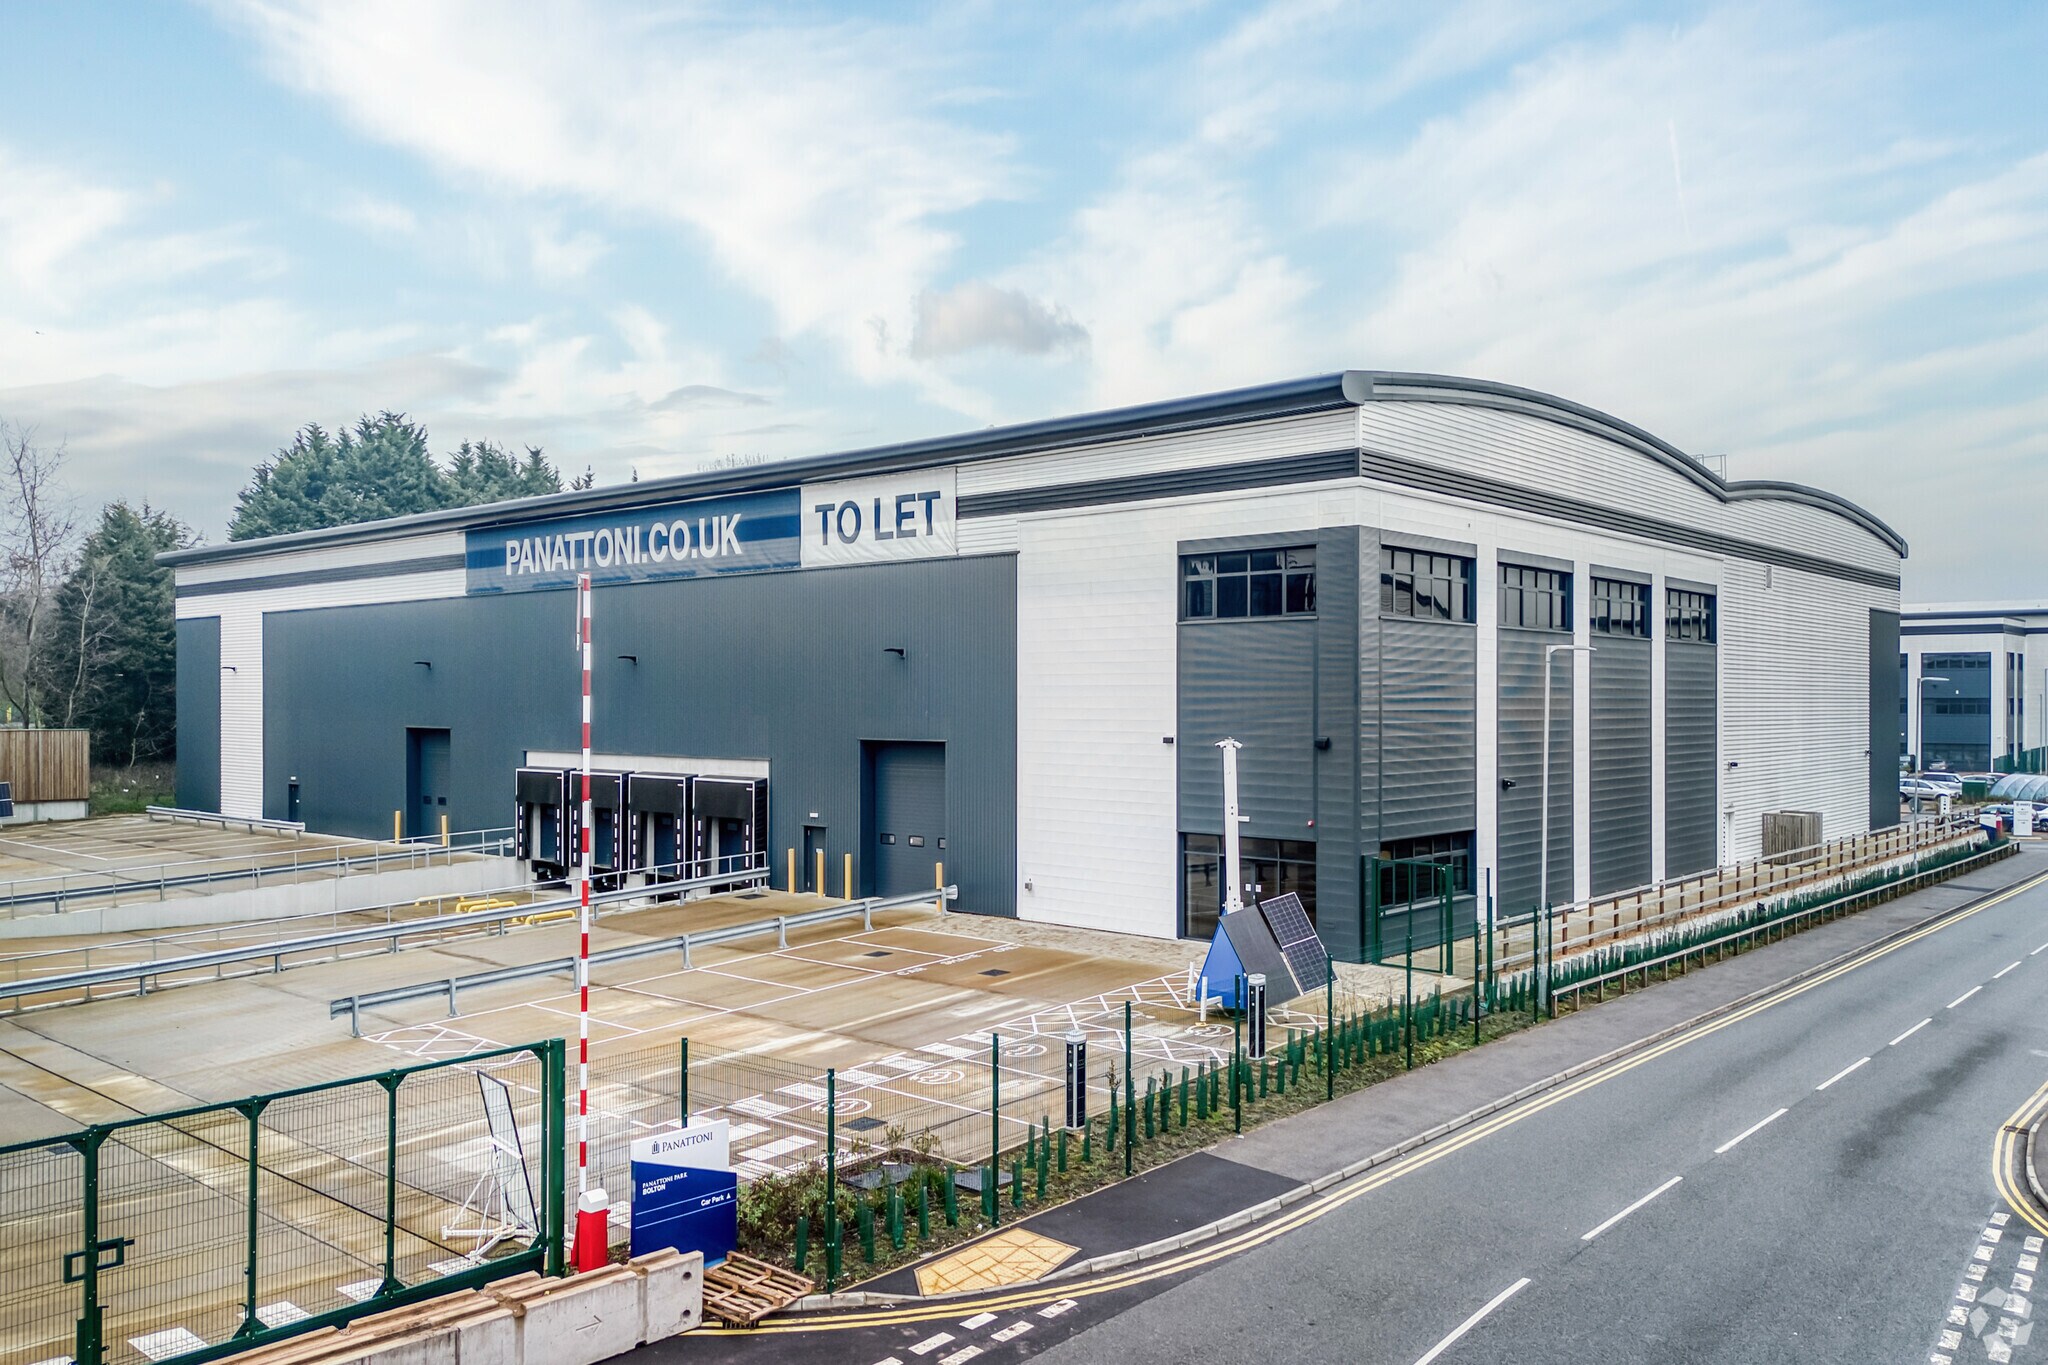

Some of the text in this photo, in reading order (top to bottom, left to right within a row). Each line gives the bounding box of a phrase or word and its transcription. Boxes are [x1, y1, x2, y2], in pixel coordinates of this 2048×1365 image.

[815, 491, 941, 545] TO LET
[505, 513, 743, 576] PANATTONI.CO.UK
[662, 1132, 712, 1152] PANATTONI
[643, 1172, 687, 1188] PANATTONI PARK
[643, 1184, 665, 1195] BOLTON
[712, 1195, 724, 1203] Park
